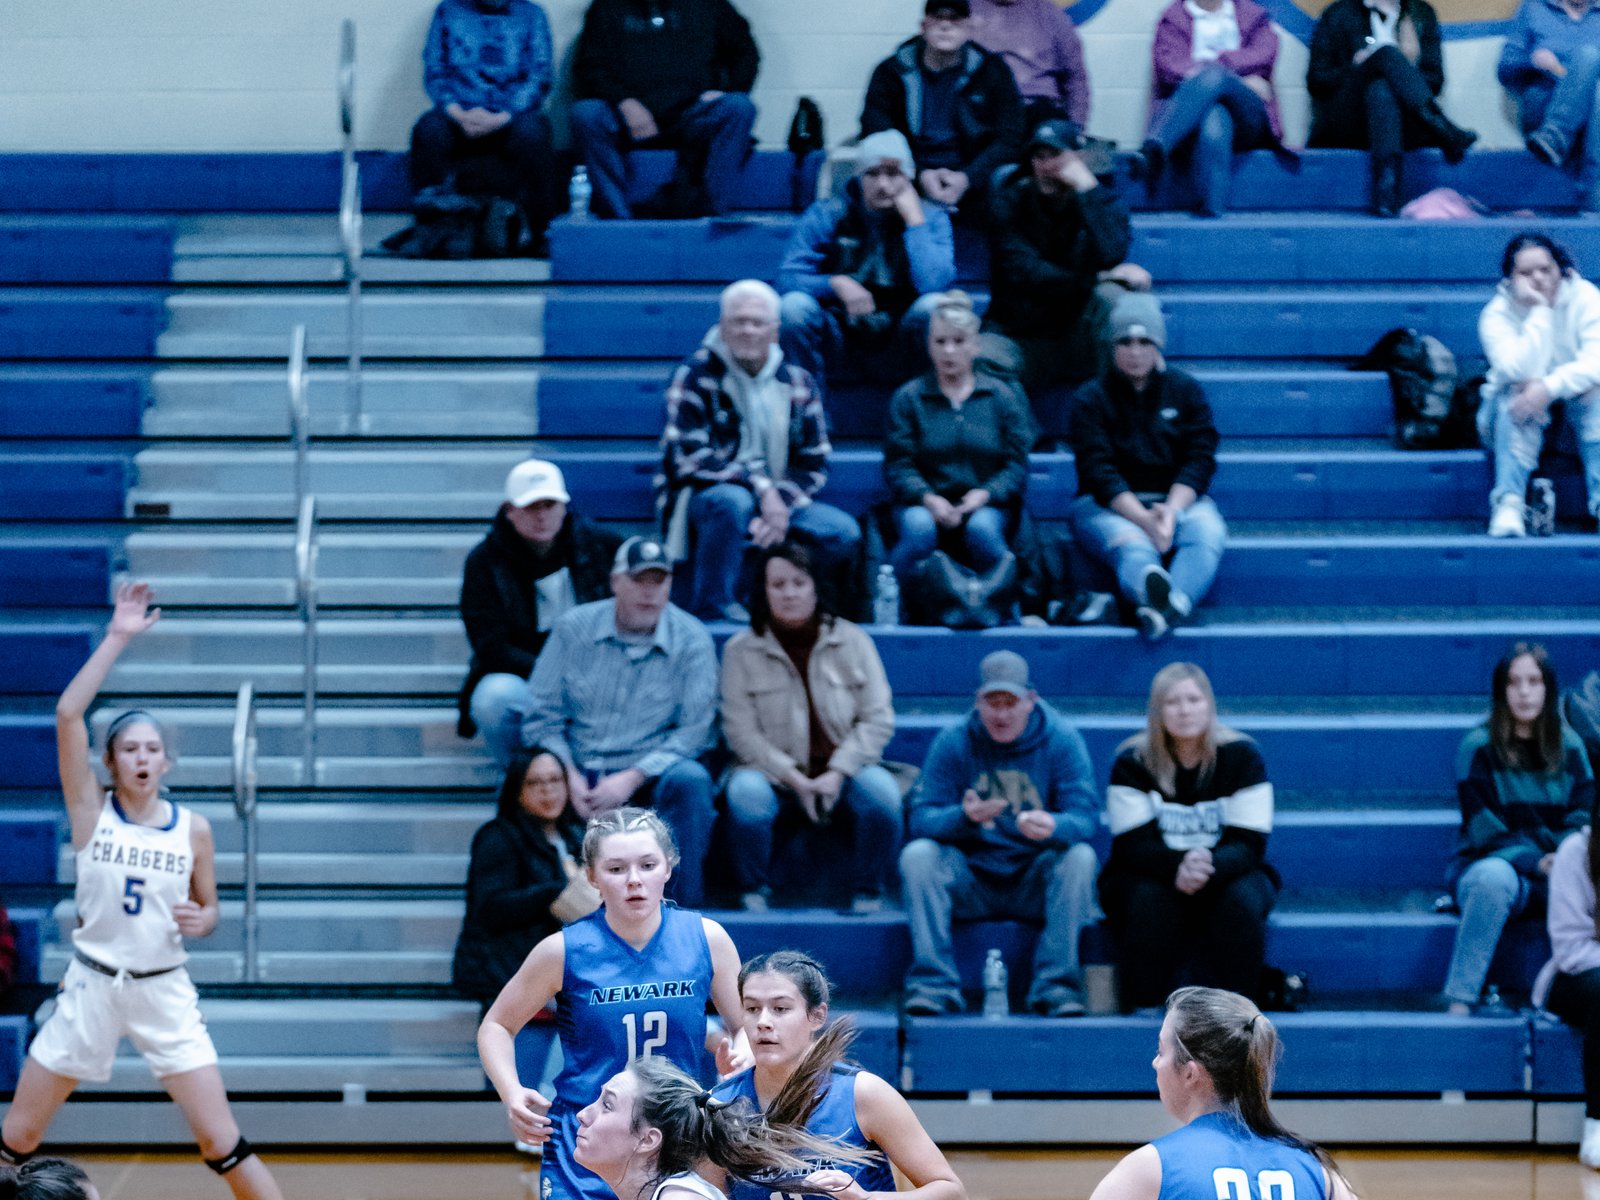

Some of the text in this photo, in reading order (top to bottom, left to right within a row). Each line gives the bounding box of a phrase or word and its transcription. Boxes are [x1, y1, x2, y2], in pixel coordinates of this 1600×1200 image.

[92, 841, 187, 875] CHARGERS
[123, 876, 146, 917] 5
[589, 979, 697, 1006] NEWARK
[622, 1010, 668, 1062] 12
